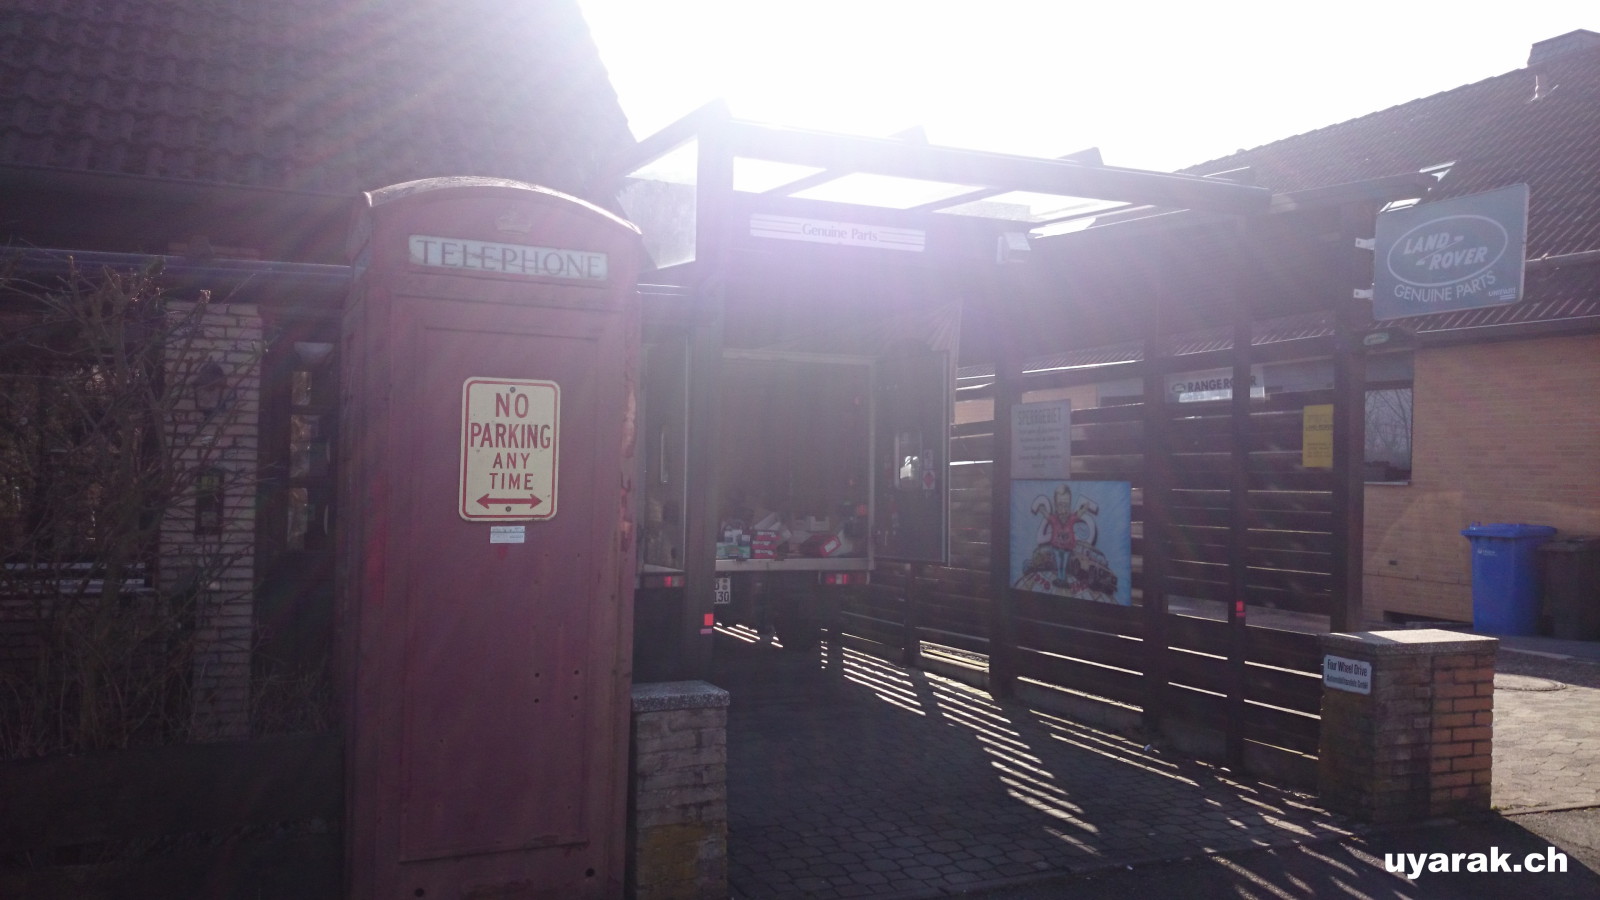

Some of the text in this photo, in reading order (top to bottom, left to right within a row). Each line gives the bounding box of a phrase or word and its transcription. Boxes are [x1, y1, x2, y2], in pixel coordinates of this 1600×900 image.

[802, 223, 879, 242] Genuine Parts
[1403, 232, 1451, 255] LAND
[415, 239, 601, 278] TELEPHONE
[1428, 246, 1488, 270] ROVER
[1394, 270, 1496, 303] GENUINE PARTS
[1187, 378, 1222, 393] RANGE
[495, 392, 529, 419] NO
[470, 422, 551, 449] PARKING
[492, 452, 531, 470] ANY
[489, 472, 534, 491] TIME
[1327, 658, 1368, 677] Four Wheel Drive
